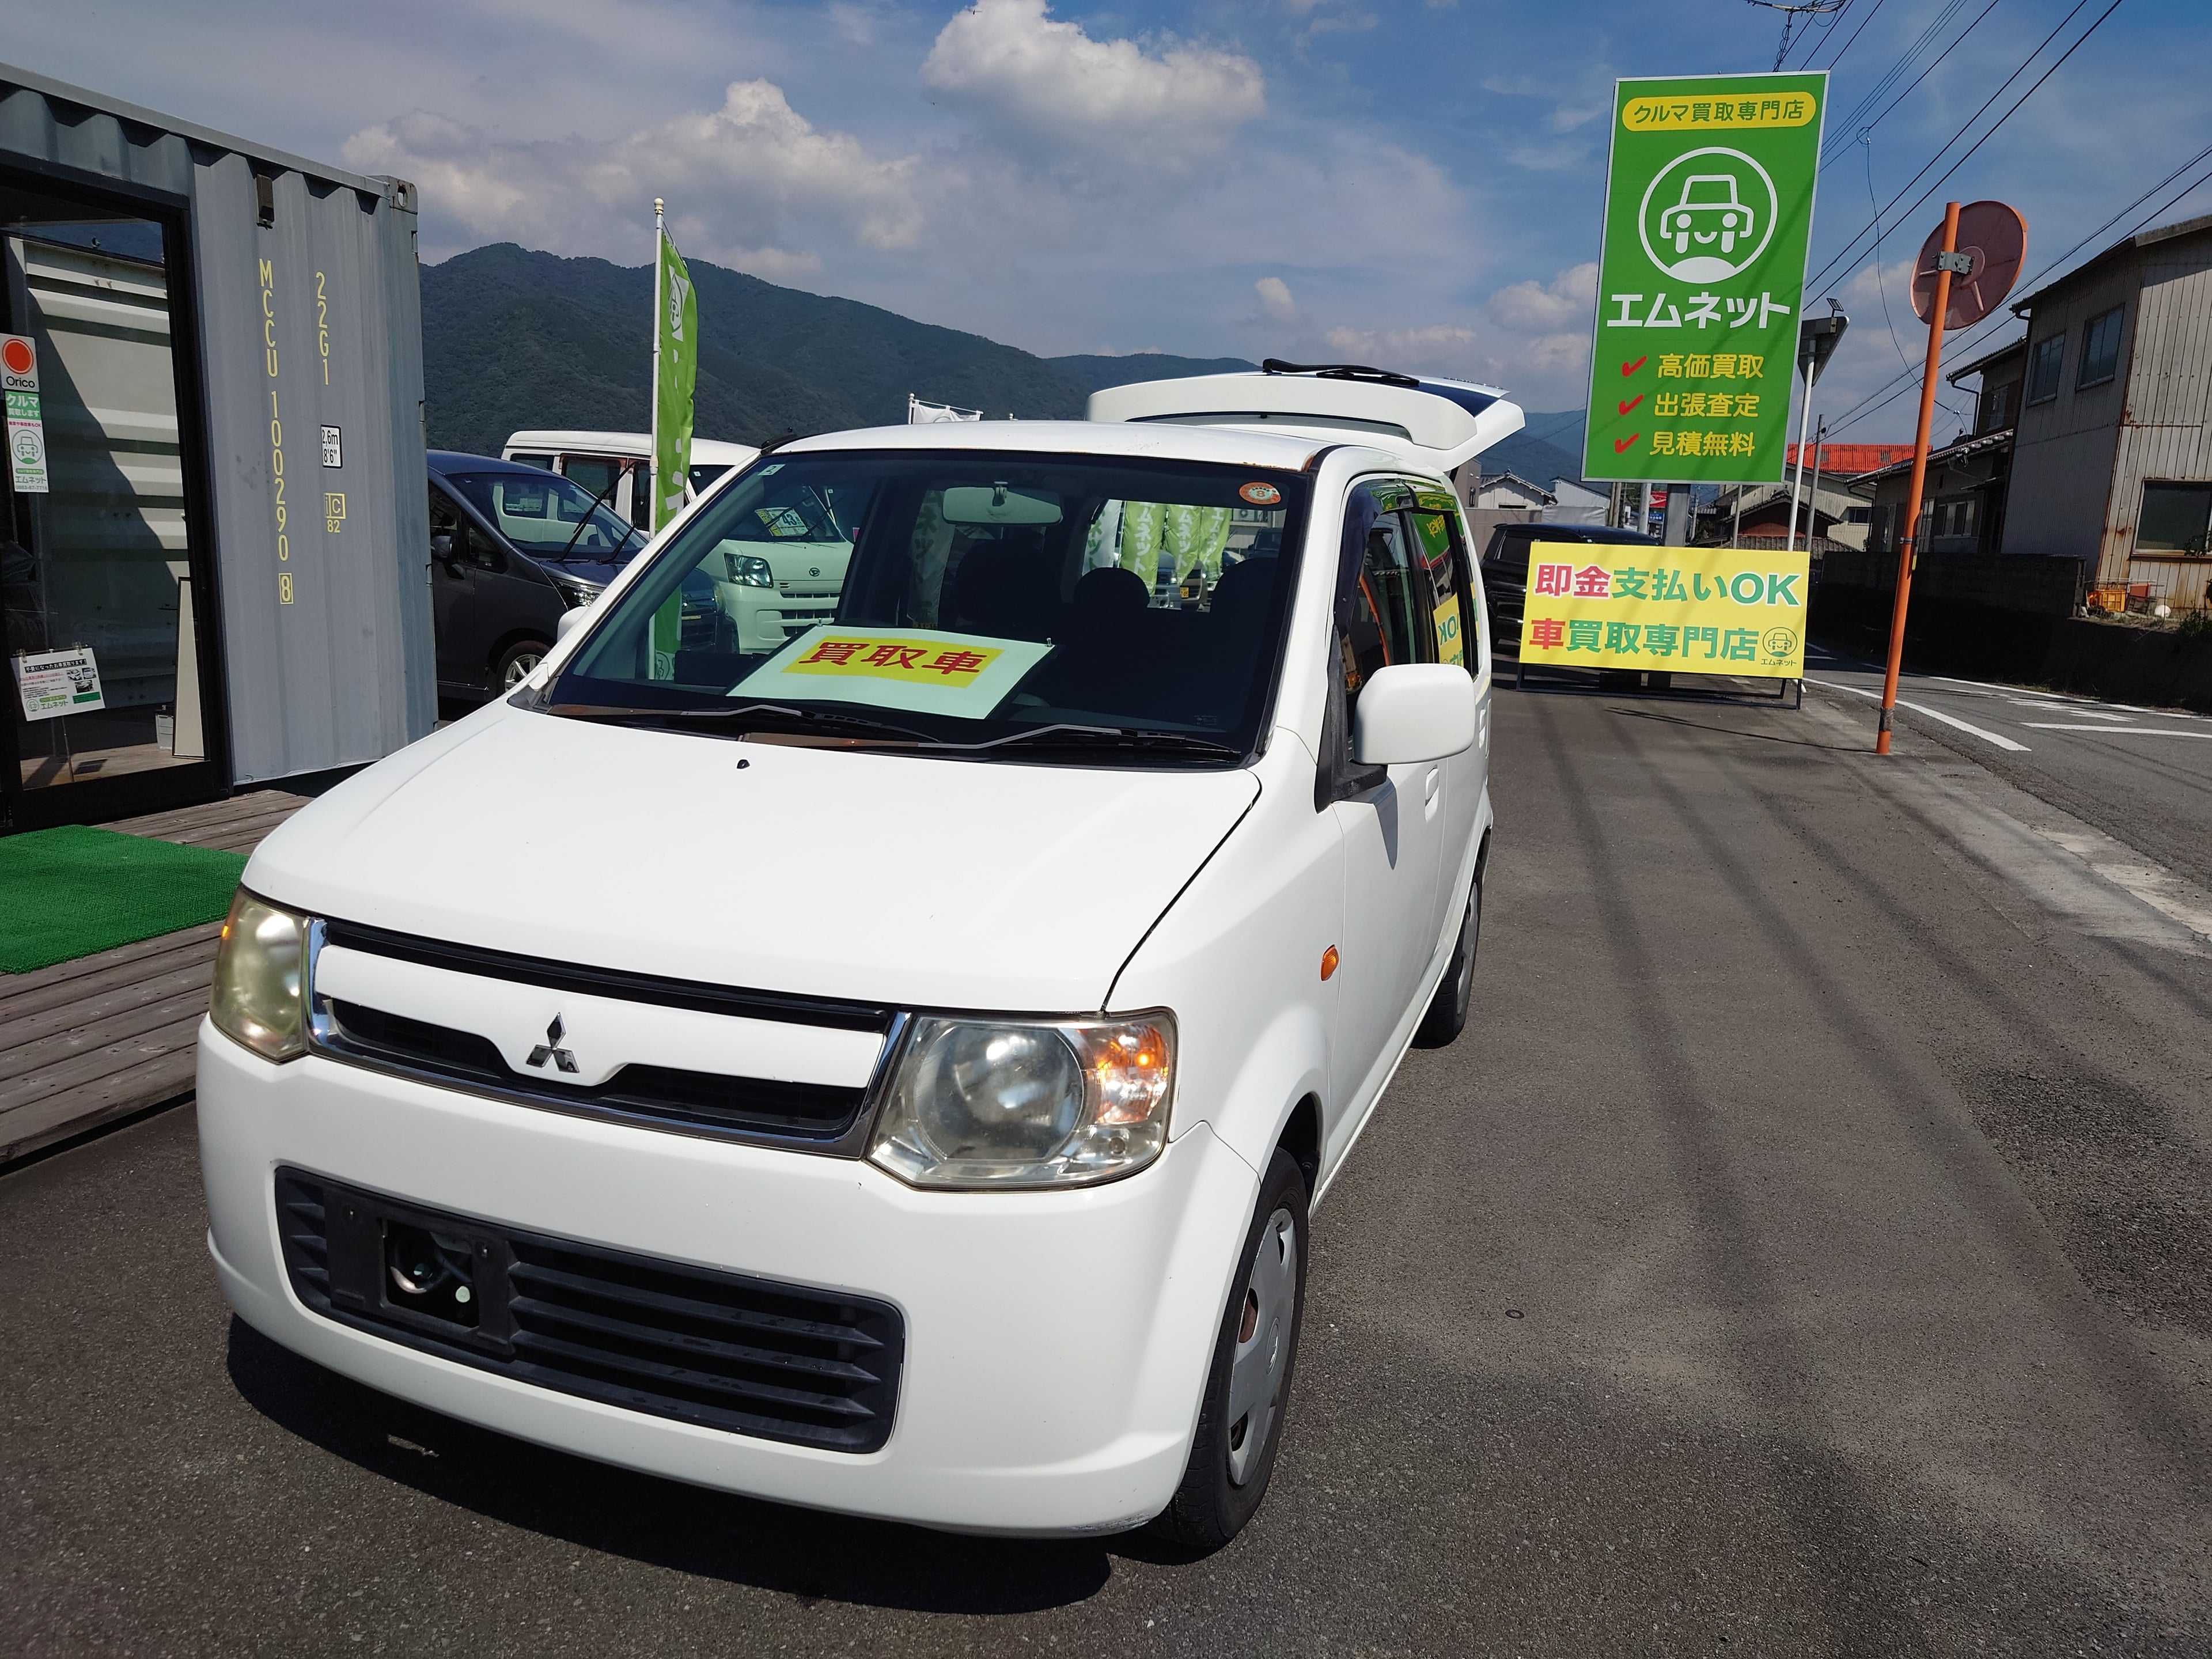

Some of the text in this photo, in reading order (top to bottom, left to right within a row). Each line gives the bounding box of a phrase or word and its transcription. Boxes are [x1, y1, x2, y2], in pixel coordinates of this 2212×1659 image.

[1634, 99, 1805, 124] クルマ買取専門店
[1607, 291, 1791, 329] エムネット
[316, 271, 329, 385] 22G1
[1657, 353, 1764, 380] 高価買取
[6, 376, 35, 388] Orico
[6, 394, 39, 408] クルマ
[259, 258, 278, 377] MCCU
[271, 391, 289, 562] 100290
[1654, 392, 1760, 418] 出張査定
[1649, 431, 1755, 457] 見積無料
[15, 476, 47, 484] エムネット
[327, 519, 341, 533] 82
[1534, 564, 1801, 606] 即金支払いOK
[1529, 618, 1760, 662] 車買取専門店
[798, 642, 987, 675] 買取車
[1760, 658, 1797, 666] エムネット
[41, 699, 69, 710] エムネット
